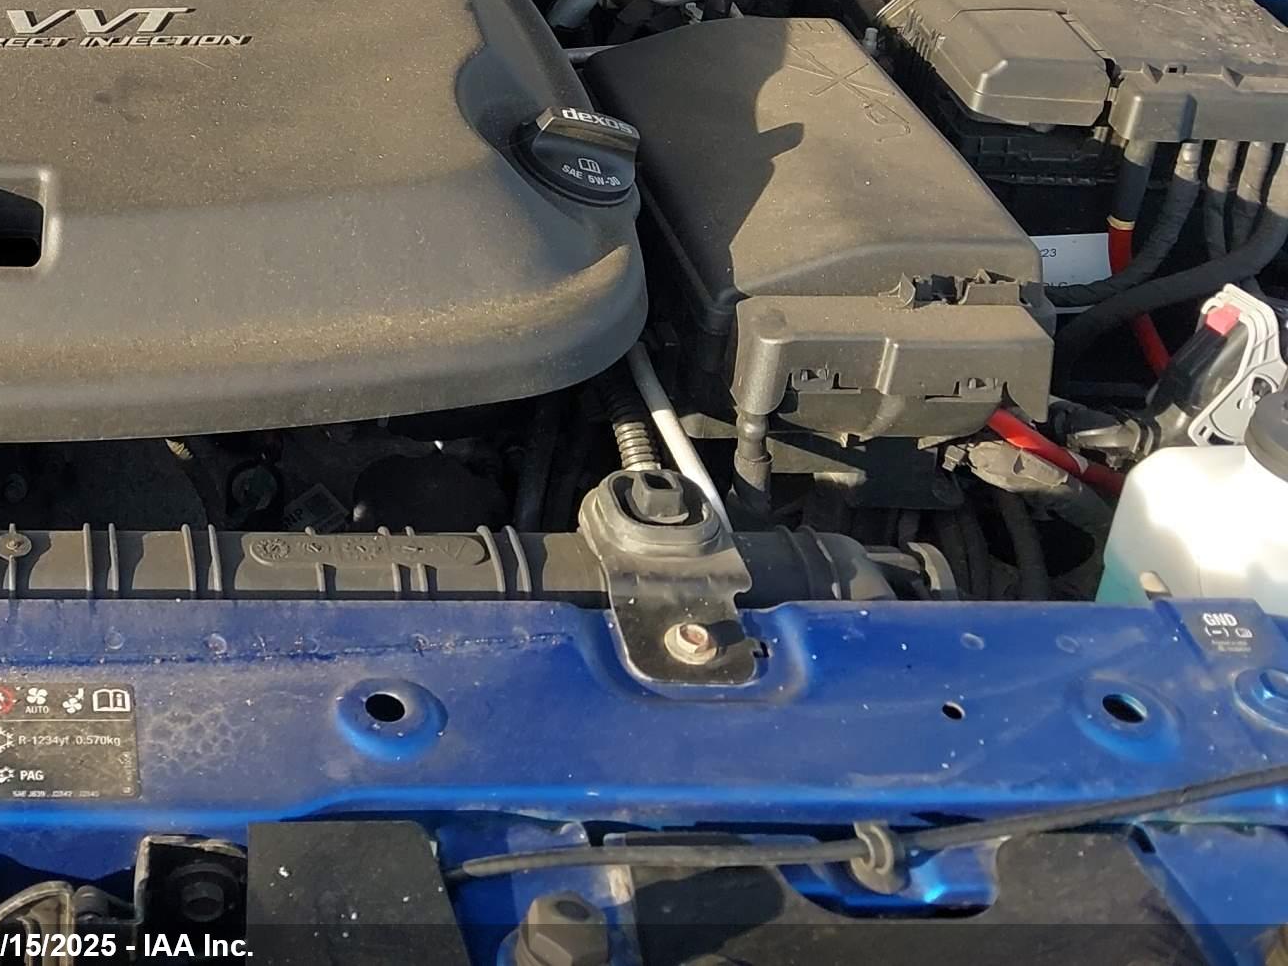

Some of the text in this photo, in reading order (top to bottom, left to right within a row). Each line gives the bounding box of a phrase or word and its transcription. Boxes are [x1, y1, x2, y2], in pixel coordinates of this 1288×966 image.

[7, 8, 196, 34] VVT
[80, 35, 253, 46] INJECTION
[562, 108, 633, 133] dexos
[562, 165, 620, 186] SAE 5W-30
[1203, 613, 1238, 626] GND
[25, 705, 49, 714] AUTO
[18, 735, 70, 746] R-1234yf
[20, 770, 44, 781] PAG
